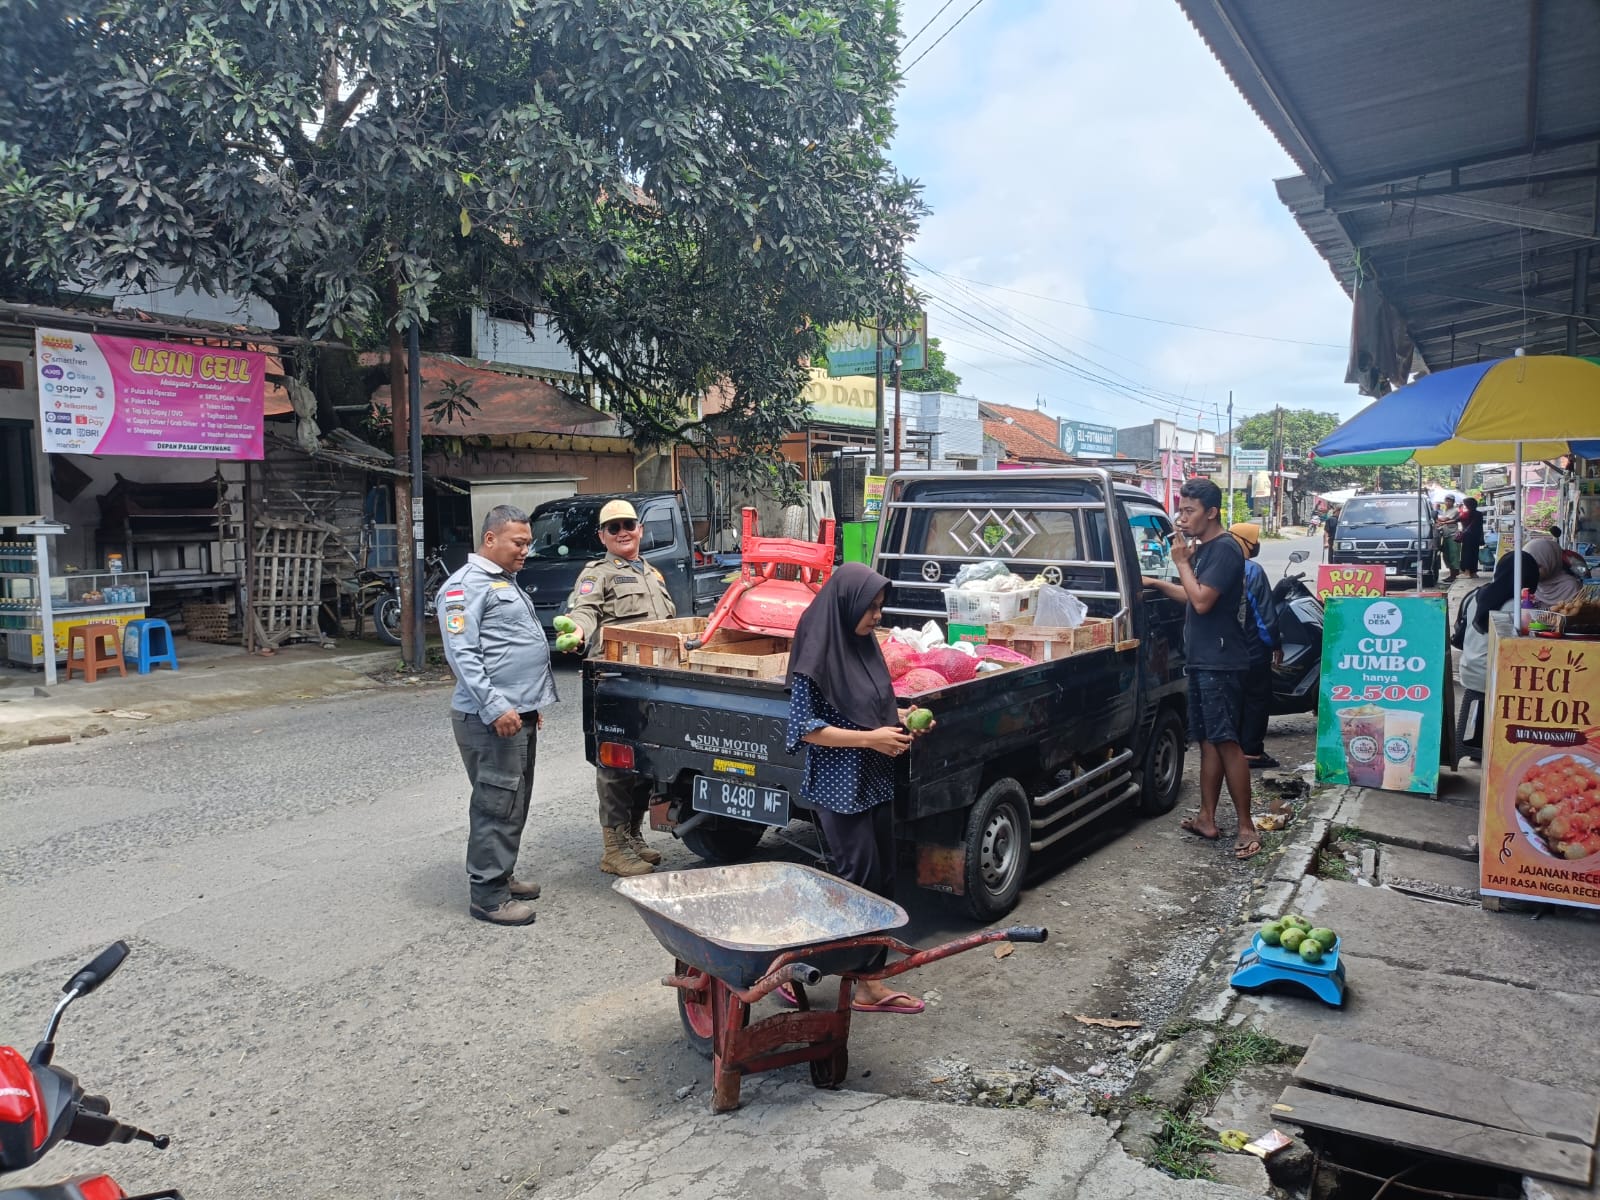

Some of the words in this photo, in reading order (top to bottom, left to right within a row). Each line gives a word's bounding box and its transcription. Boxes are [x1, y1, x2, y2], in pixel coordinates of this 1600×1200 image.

[52, 357, 88, 366] smartfren
[130, 346, 194, 378] LISIN
[199, 354, 251, 383] CELL
[56, 385, 88, 395] gopay
[832, 385, 877, 408] DAD
[64, 402, 97, 411] Telkomsel
[89, 418, 104, 428] Pay
[55, 428, 72, 436] BCA
[85, 429, 99, 437] BRI
[178, 443, 198, 451] PASAR
[1329, 568, 1373, 584] ROTI
[1358, 637, 1408, 654] CUP
[1338, 654, 1426, 672] JUMBO
[1362, 672, 1398, 684] hanya
[1510, 665, 1571, 694] TECI
[1331, 684, 1431, 702] 2.500
[1498, 694, 1592, 726] TELOR
[696, 745, 720, 753] CILACAP
[697, 734, 720, 746] SUN
[723, 738, 768, 754] MOTOR
[700, 779, 708, 800] R
[722, 783, 755, 809] 8480
[764, 791, 781, 813] MF
[1518, 865, 1569, 880] JAJANAN
[1571, 871, 1600, 885] RECE
[1488, 874, 1508, 885] TAPI
[1510, 878, 1537, 890] RASA
[1539, 882, 1570, 895] NGGA
